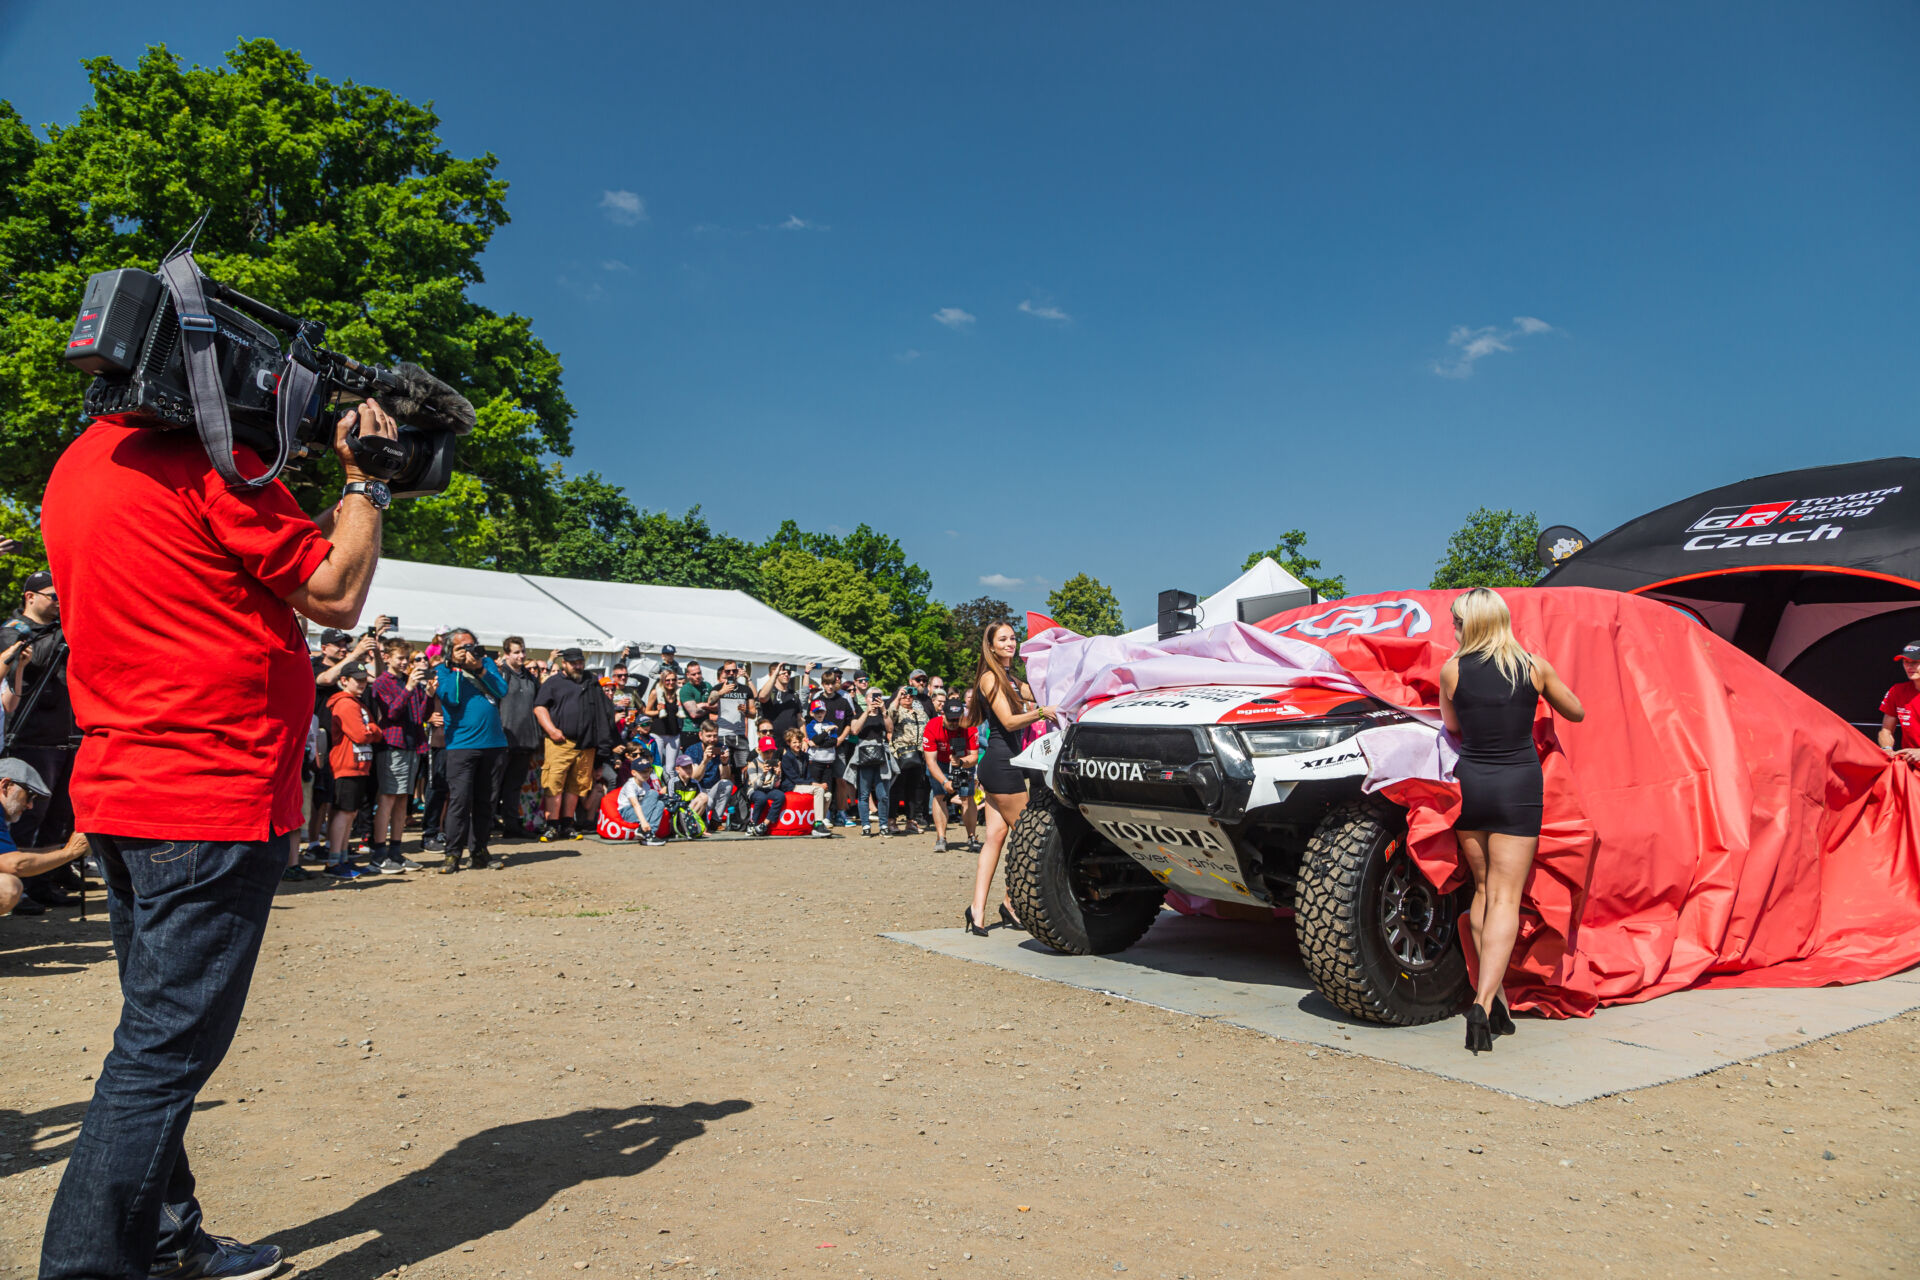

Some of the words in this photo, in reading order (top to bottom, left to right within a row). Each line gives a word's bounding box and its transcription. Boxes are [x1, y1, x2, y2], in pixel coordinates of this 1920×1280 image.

[1788, 497, 1886, 515] GAZOO
[1801, 486, 1903, 507] TOYOTA
[1693, 510, 1779, 530] GR
[1778, 506, 1875, 524] Racing
[1683, 523, 1844, 551] Czech
[1112, 700, 1190, 709] Czech
[1078, 759, 1144, 781] TOYOTA
[1098, 820, 1225, 852] TOYOTA
[1132, 851, 1169, 864] over
